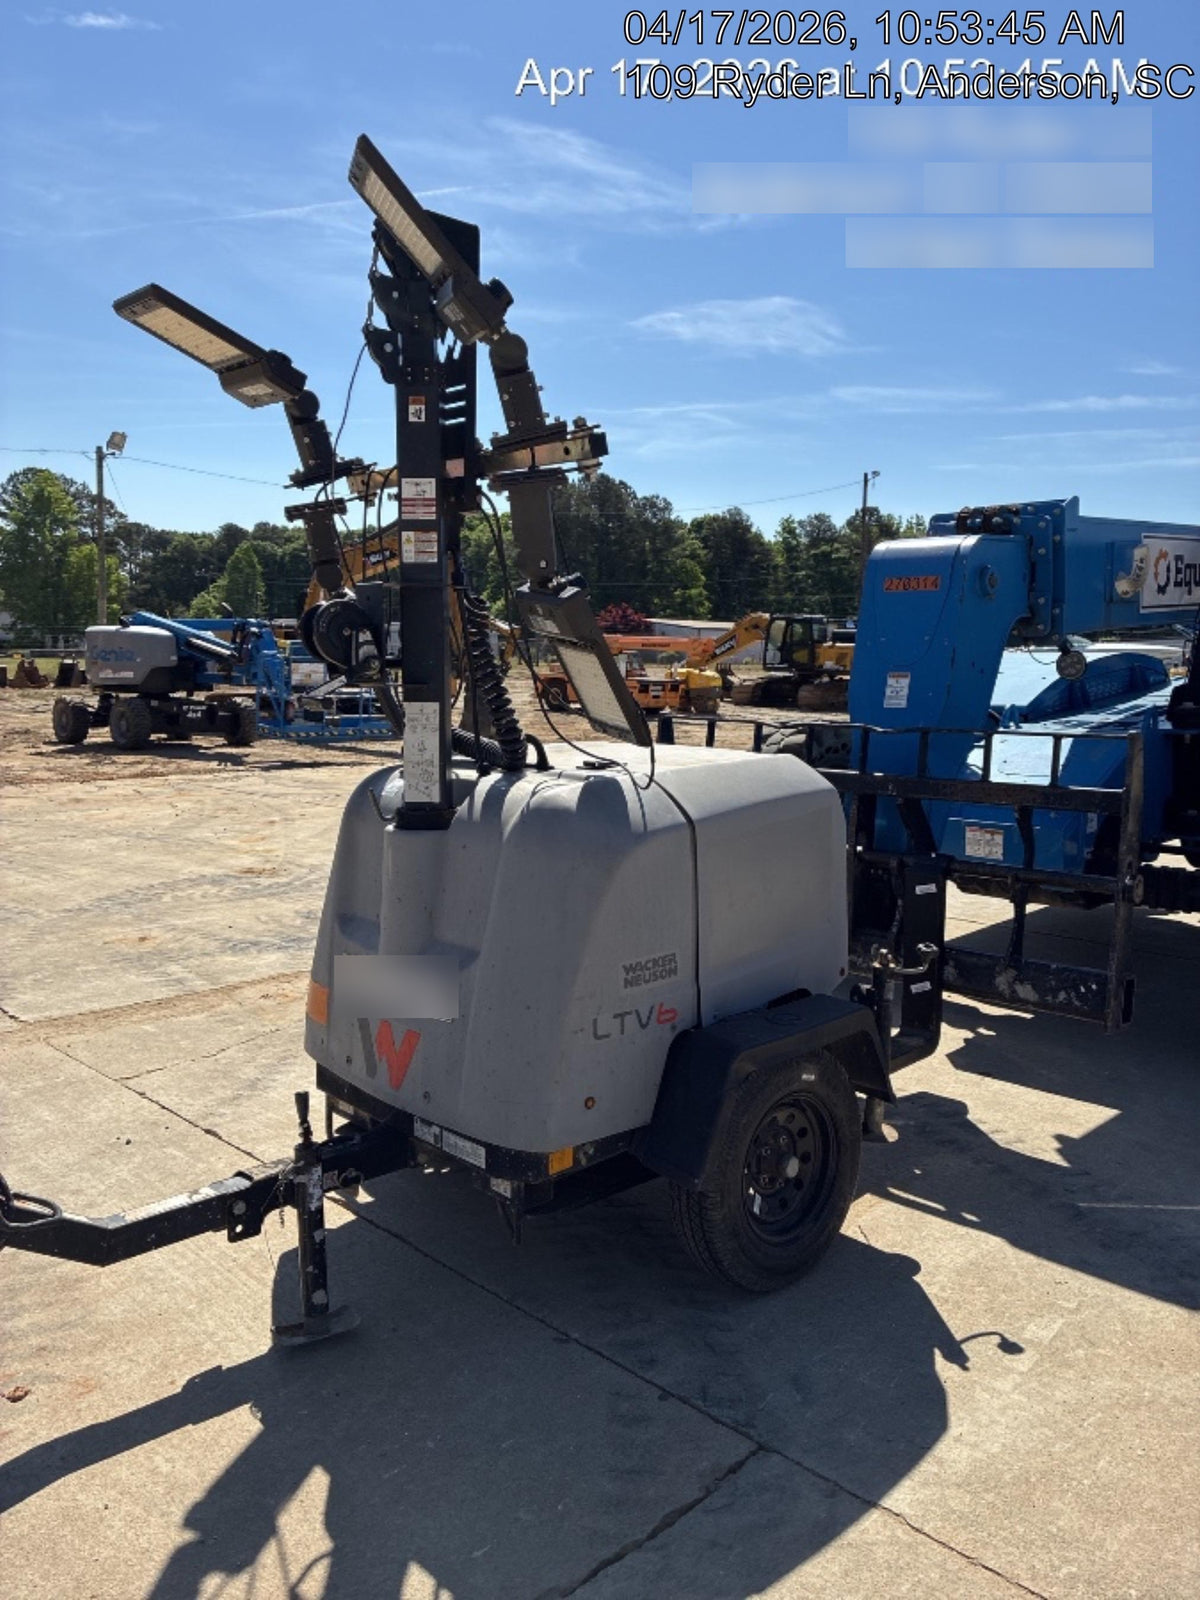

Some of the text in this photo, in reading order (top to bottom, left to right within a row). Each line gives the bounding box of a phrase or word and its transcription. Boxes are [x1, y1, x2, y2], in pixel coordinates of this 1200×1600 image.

[622, 952, 678, 976] WACKER
[623, 965, 678, 989] NEUSON
[592, 1001, 678, 1041] LTV6
